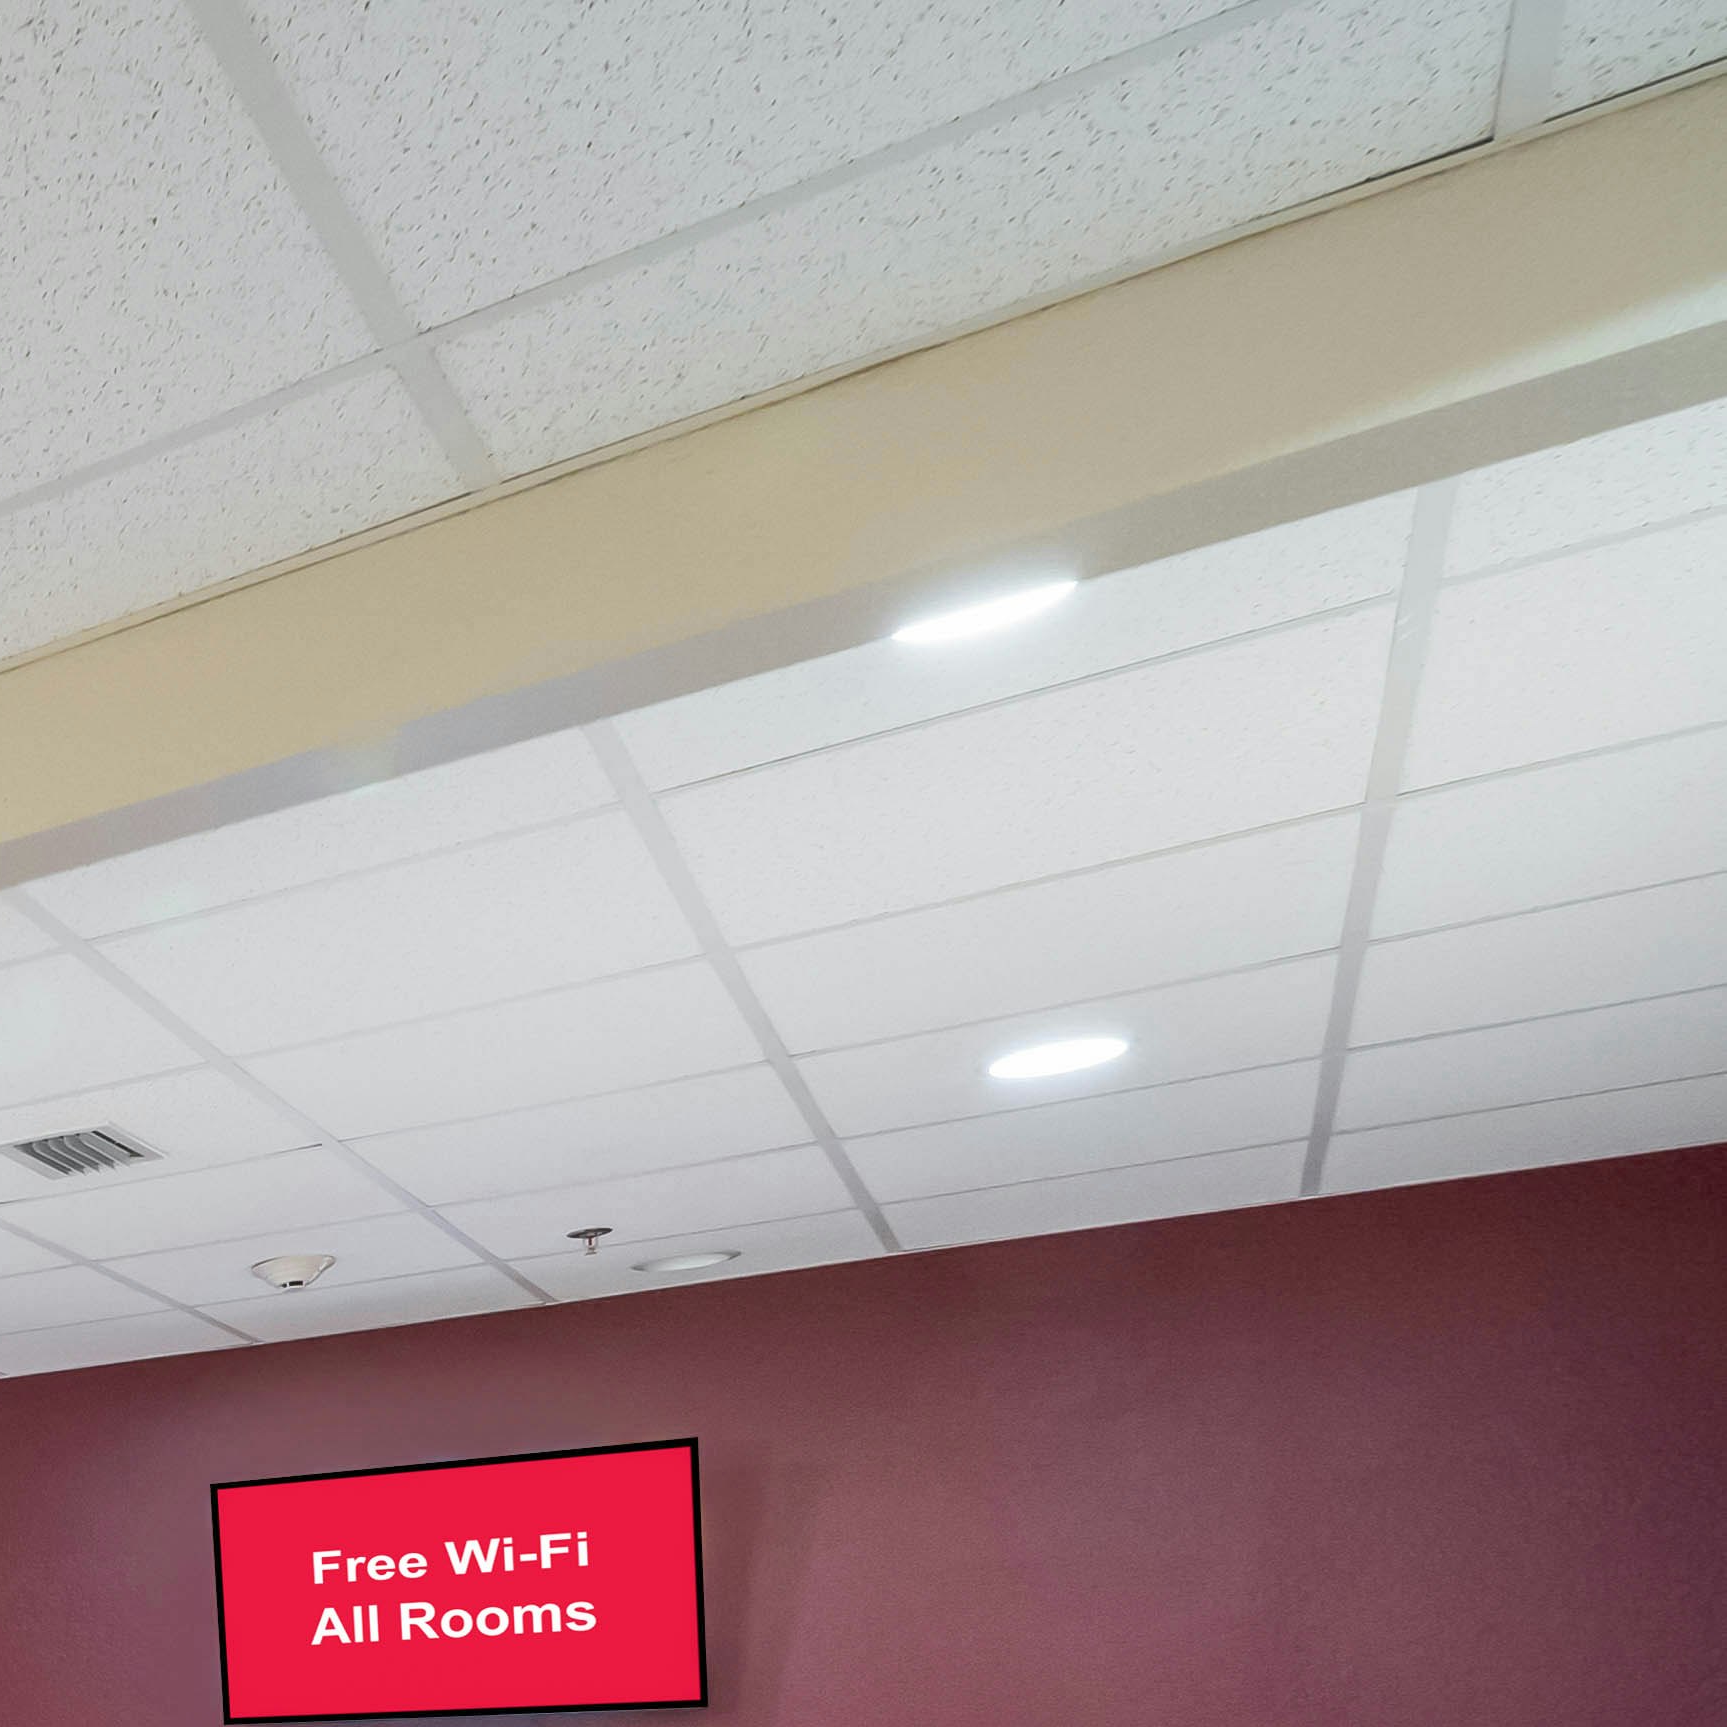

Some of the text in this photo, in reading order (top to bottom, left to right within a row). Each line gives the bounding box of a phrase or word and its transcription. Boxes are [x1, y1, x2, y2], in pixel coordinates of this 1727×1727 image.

[312, 1531, 589, 1584] Free Wi-Fi
[311, 1599, 597, 1646] All Rooms
